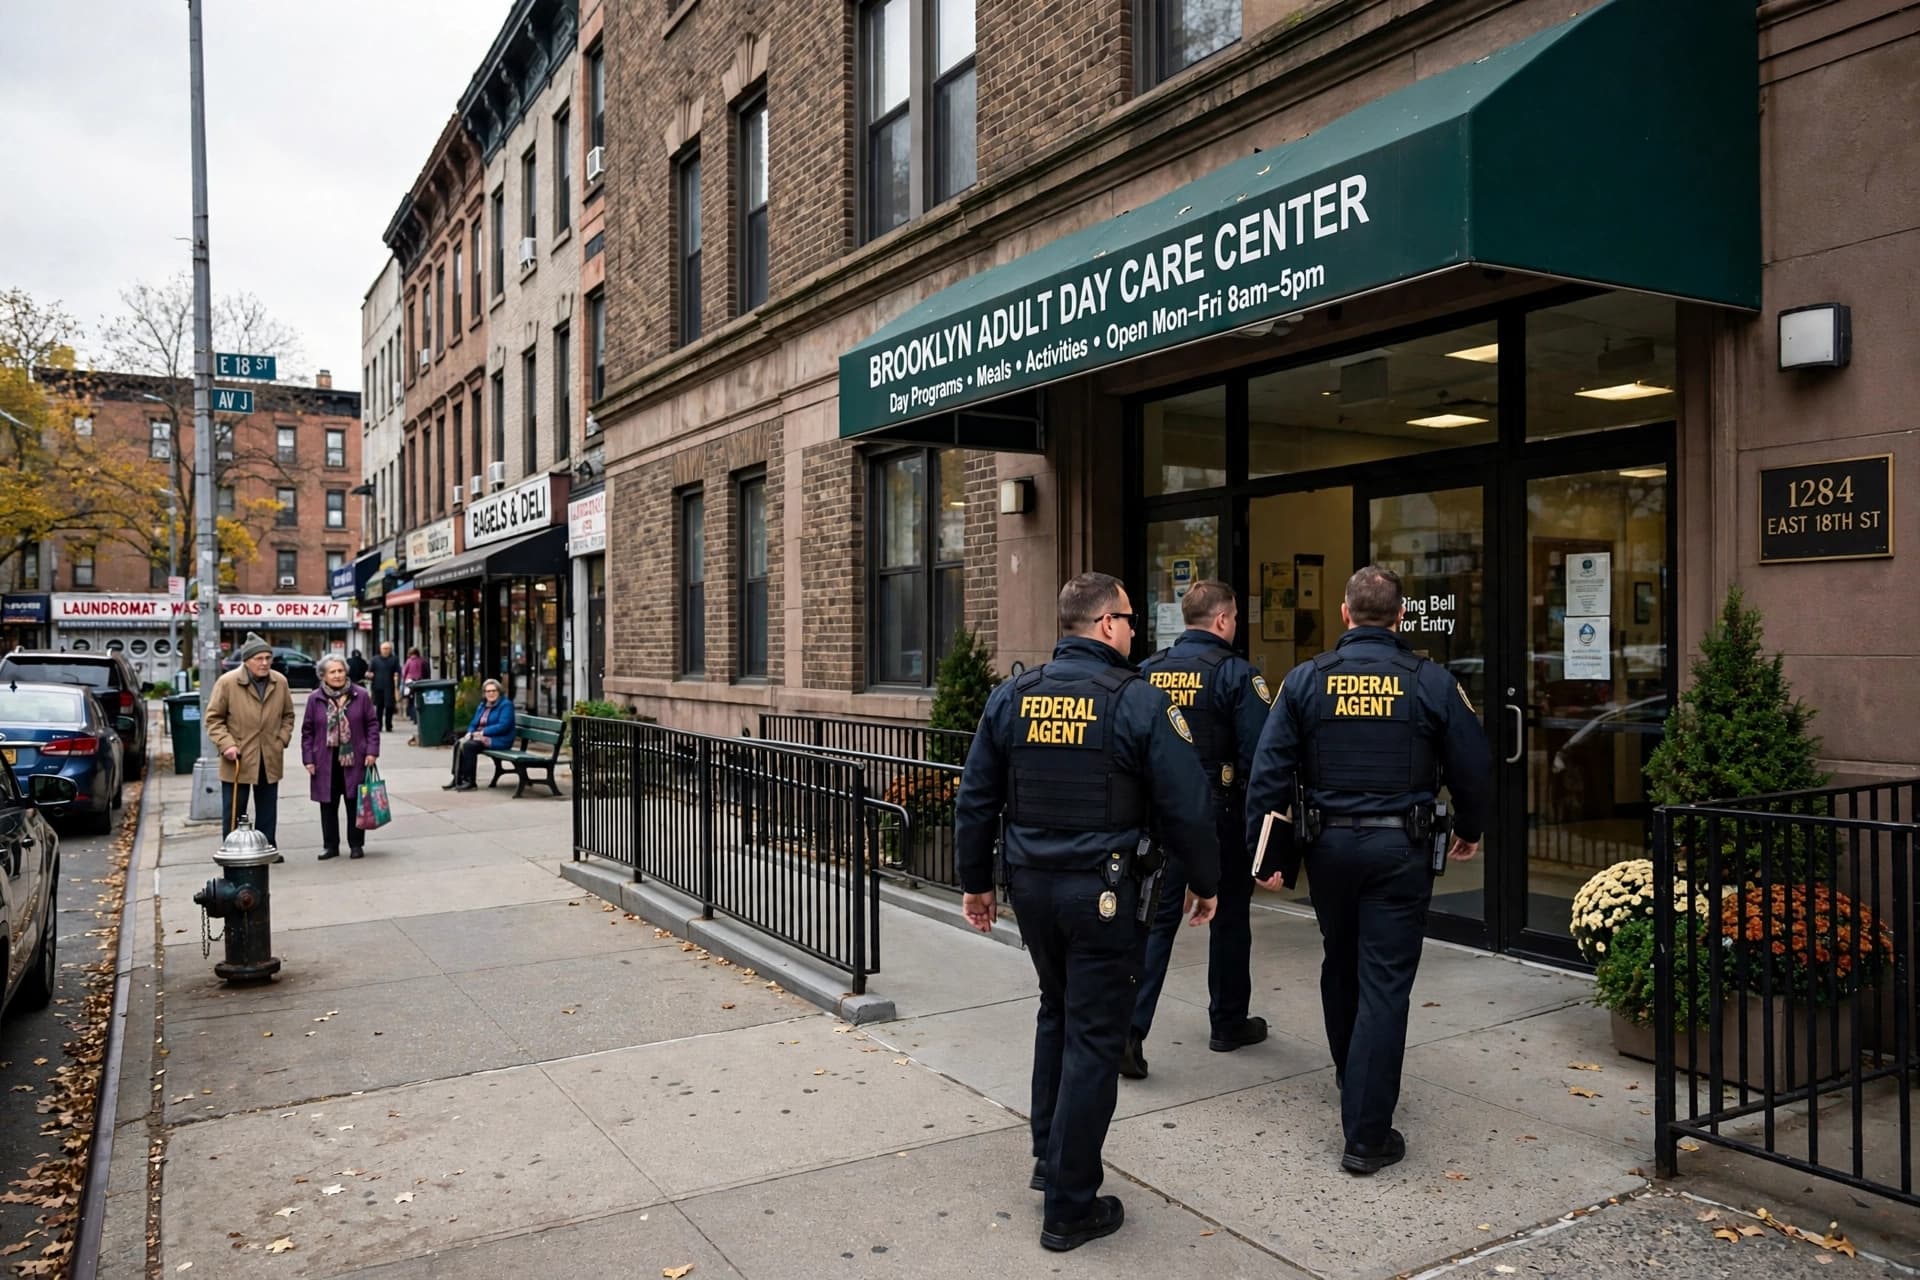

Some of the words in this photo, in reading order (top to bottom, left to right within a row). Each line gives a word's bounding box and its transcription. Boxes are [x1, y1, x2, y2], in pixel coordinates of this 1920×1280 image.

[869, 320, 972, 389] BROOKLYN
[977, 290, 1053, 353] ADULT
[1060, 267, 1113, 325] DAY
[1120, 233, 1205, 303] CARE
[1214, 174, 1370, 271] CENTER
[220, 356, 229, 374] E
[235, 357, 251, 376] 18
[256, 358, 269, 371] ST
[889, 391, 909, 414] Day
[911, 376, 963, 407] Programs
[976, 358, 1012, 388] Meals
[1025, 337, 1088, 374] Activities
[1106, 319, 1148, 352] Open
[218, 391, 235, 409] AV
[240, 393, 248, 410] J
[1788, 475, 1854, 508] 1284
[473, 500, 508, 538] BAGELS
[510, 495, 518, 526] &
[521, 485, 546, 524] DELI
[1768, 516, 1808, 535] EAST
[1815, 512, 1853, 532] 18TH
[1860, 510, 1881, 529] ST
[63, 601, 157, 615] LAUNDROMAT
[171, 601, 201, 615] WAS
[230, 603, 263, 615] FOLD
[276, 603, 309, 615] OPEN
[312, 603, 340, 616] 24/7
[1430, 594, 1455, 611] Bell
[1420, 615, 1456, 635] Entry
[1149, 671, 1204, 689] FEDERAL
[1326, 675, 1405, 695] FEDERAL
[1165, 689, 1197, 706] ENT
[1335, 696, 1395, 717] AGENT
[1019, 695, 1098, 721] FEDERAL
[1026, 720, 1088, 745] AGENT
